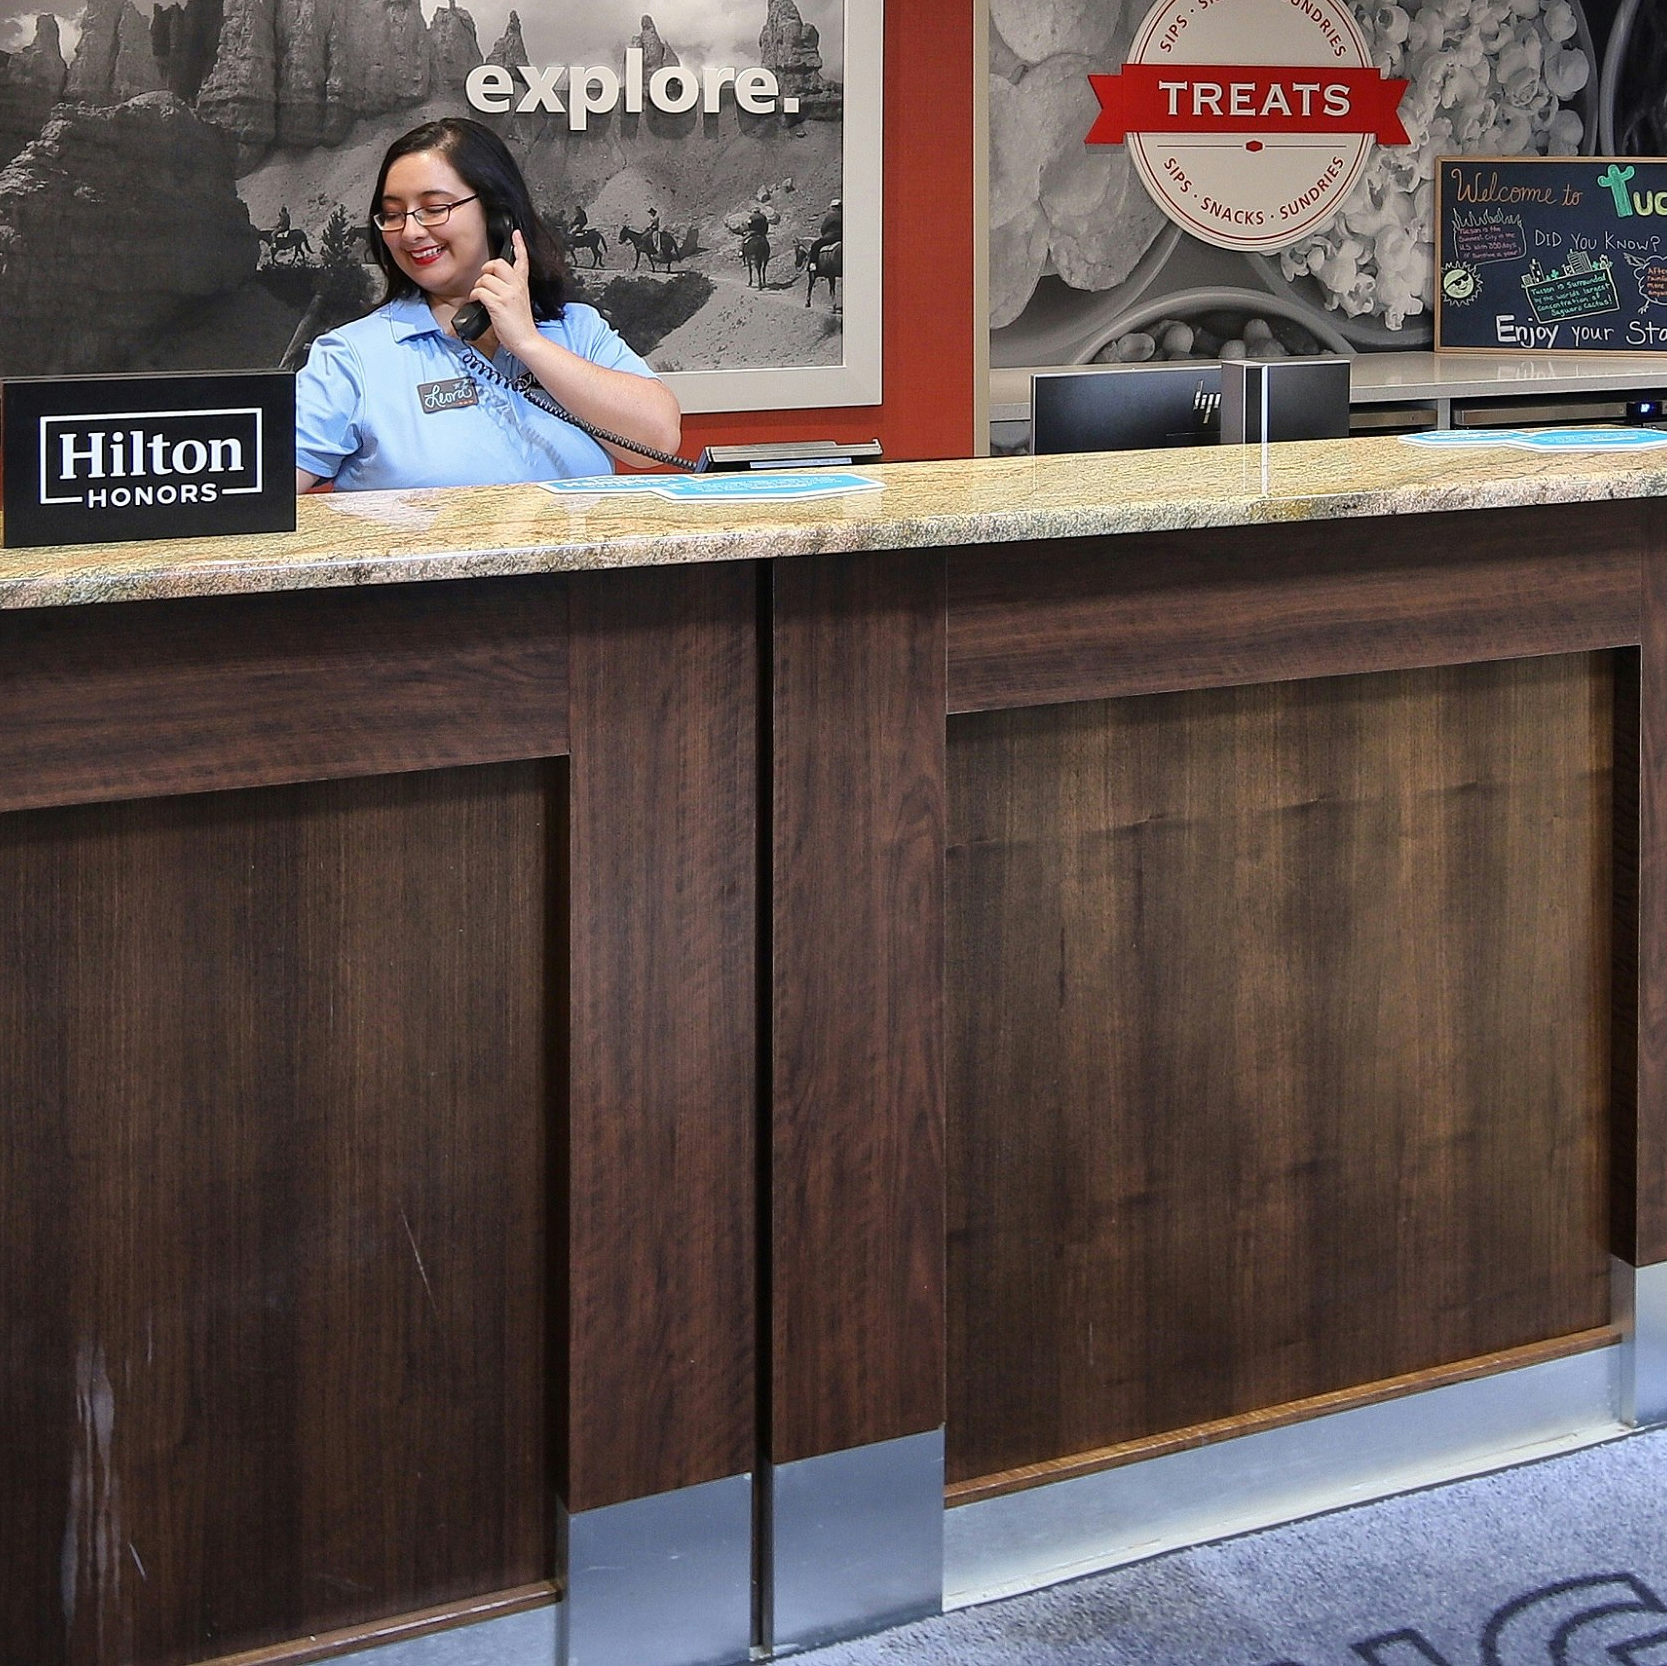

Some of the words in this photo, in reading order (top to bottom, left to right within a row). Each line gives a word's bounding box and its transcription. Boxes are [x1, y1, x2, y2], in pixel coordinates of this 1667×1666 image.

[1159, 13, 1188, 53] SIPS
[465, 47, 801, 131] explore.
[1158, 80, 1351, 117] TREATS
[1164, 157, 1192, 193] SIPS
[1200, 196, 1264, 225] SNACKS
[1279, 156, 1344, 220] SUNDRIES
[1451, 168, 1557, 204] Welcome
[1561, 184, 1583, 206] to
[1535, 230, 1562, 247] DID
[1531, 286, 1555, 295] Tucson
[1557, 282, 1565, 290] is
[1592, 292, 1601, 301] of
[1495, 314, 1559, 349] Enjoy
[1571, 325, 1615, 347] your
[59, 430, 245, 480] Hilton
[88, 483, 218, 509] HONORS
